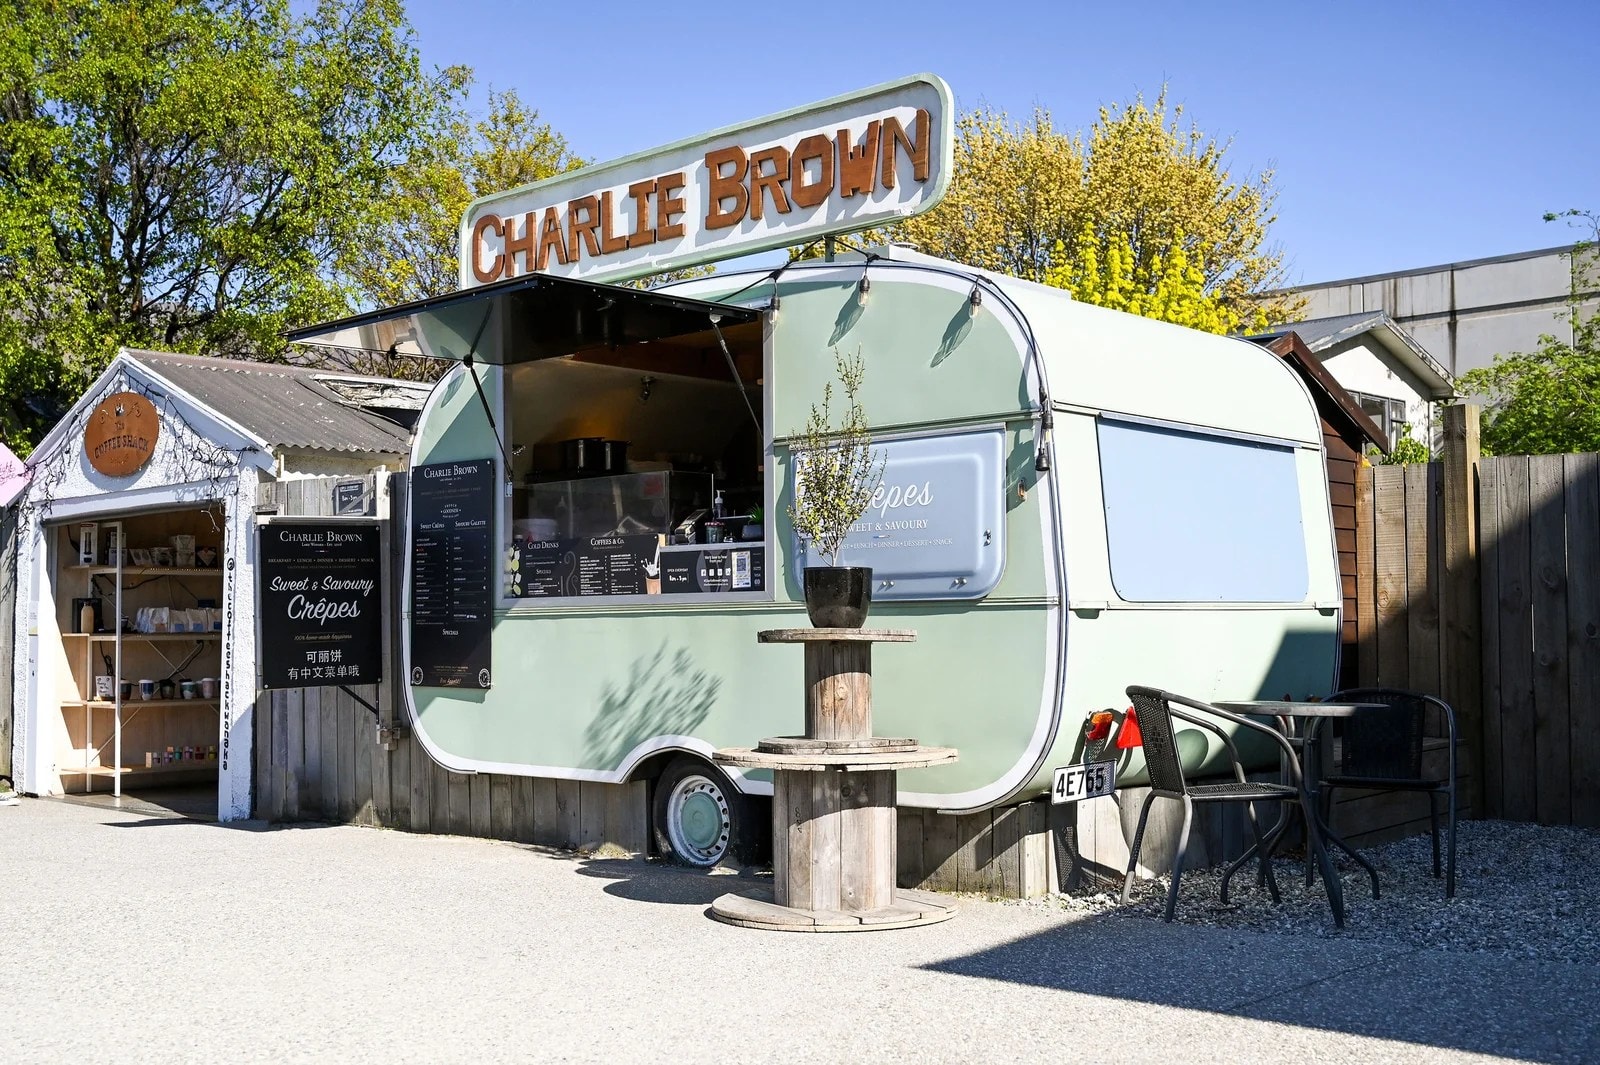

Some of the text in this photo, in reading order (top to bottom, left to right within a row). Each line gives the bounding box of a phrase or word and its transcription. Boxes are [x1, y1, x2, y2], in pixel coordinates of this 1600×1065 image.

[472, 109, 930, 284] CHARLIE BROWN
[424, 465, 478, 478] CHARLIE BROWN
[867, 480, 934, 518] êpes
[875, 522, 882, 531] &
[885, 520, 928, 530] SAVOURY
[279, 531, 362, 542] CHARLIE BROWN
[853, 541, 873, 549] LUNCH
[877, 540, 900, 548] DINNER
[903, 539, 928, 547] DESSERT
[269, 575, 374, 597] Sweet & Savoury
[287, 594, 361, 626] Crêpes
[306, 649, 342, 664] 可丽饼
[288, 664, 360, 680] 有中文菜单哦
[1055, 767, 1105, 797] 4E765
